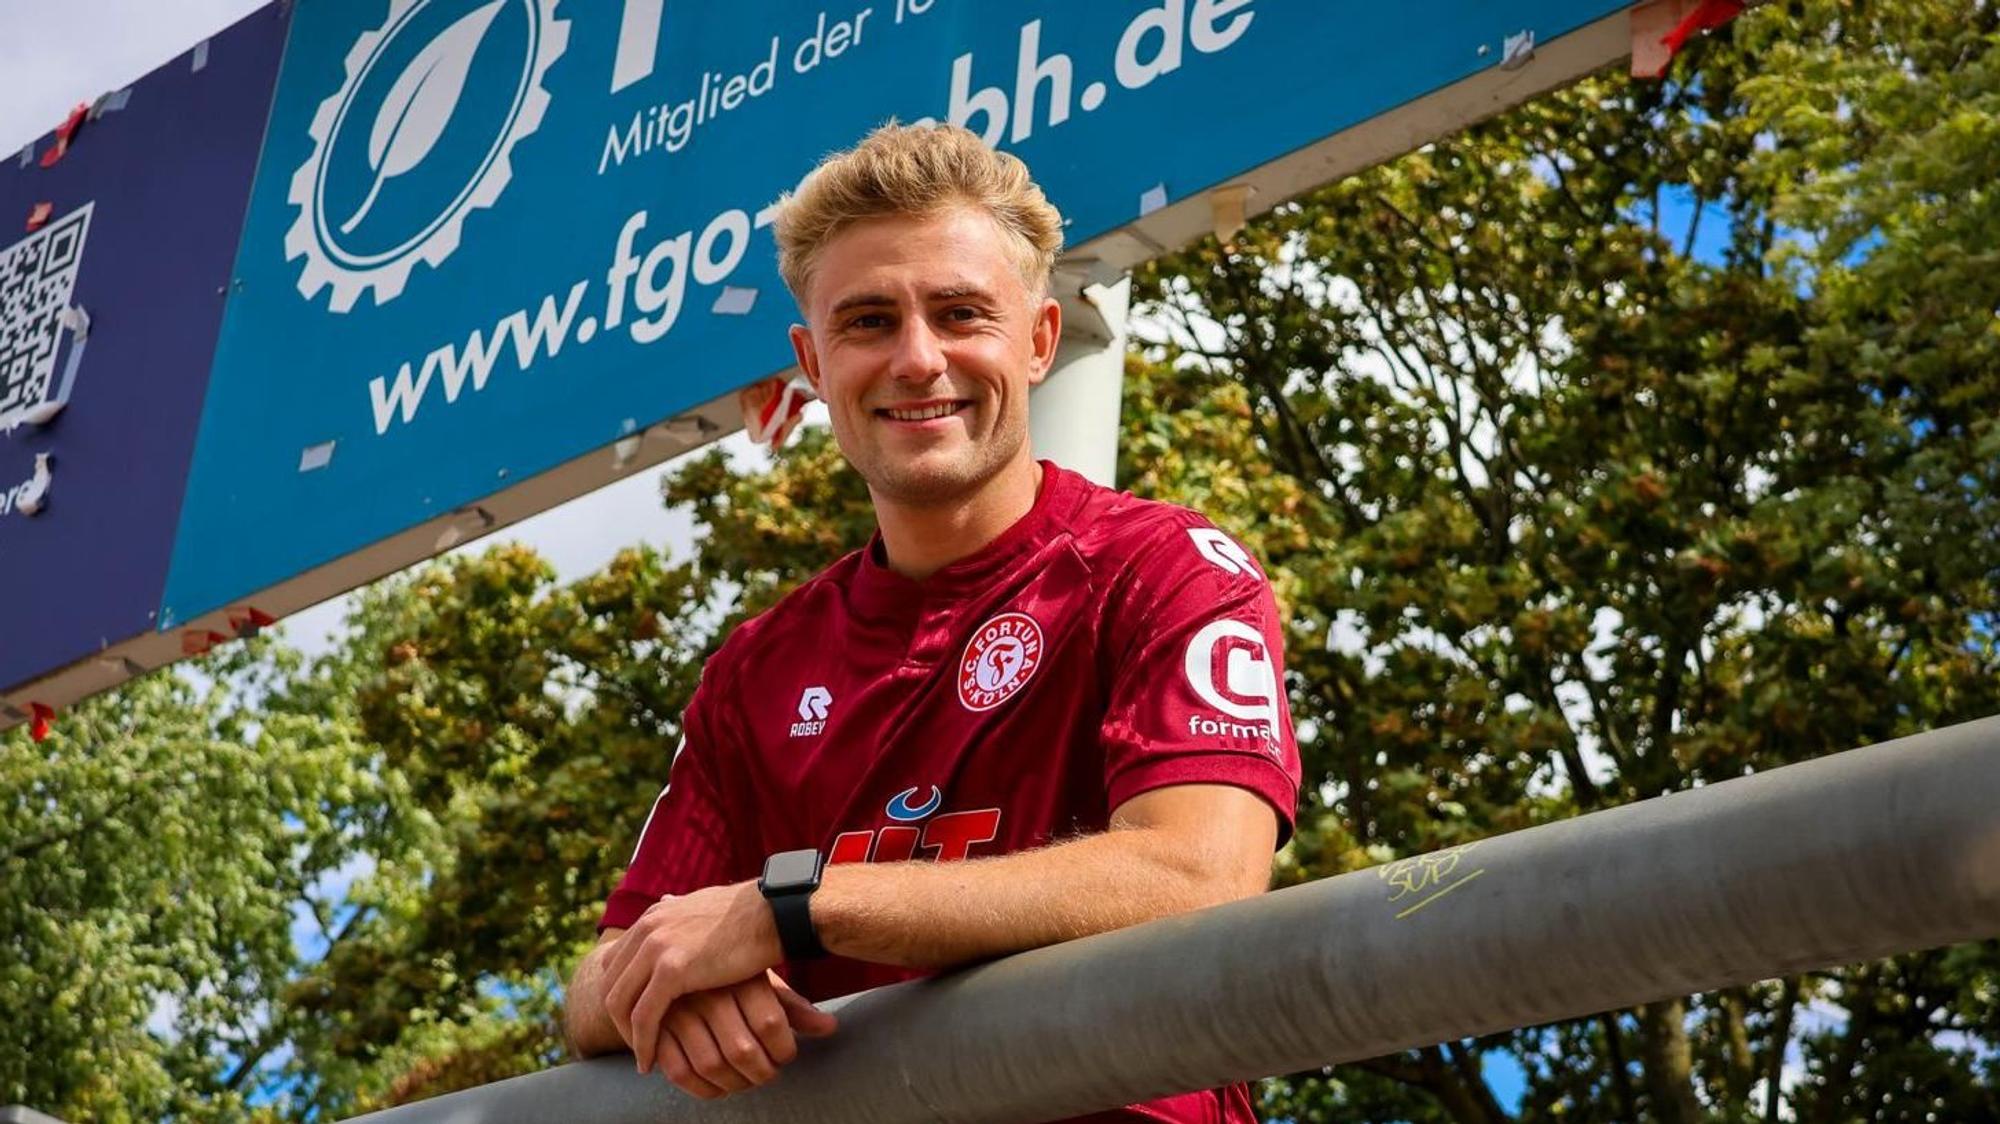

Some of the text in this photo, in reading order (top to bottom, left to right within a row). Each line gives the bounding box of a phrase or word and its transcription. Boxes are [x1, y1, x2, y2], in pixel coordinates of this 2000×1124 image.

[597, 36, 780, 176] Mitglied
[793, 8, 872, 73] der
[974, 621, 1038, 670] FORTUNA
[790, 720, 826, 738] ROBEY
